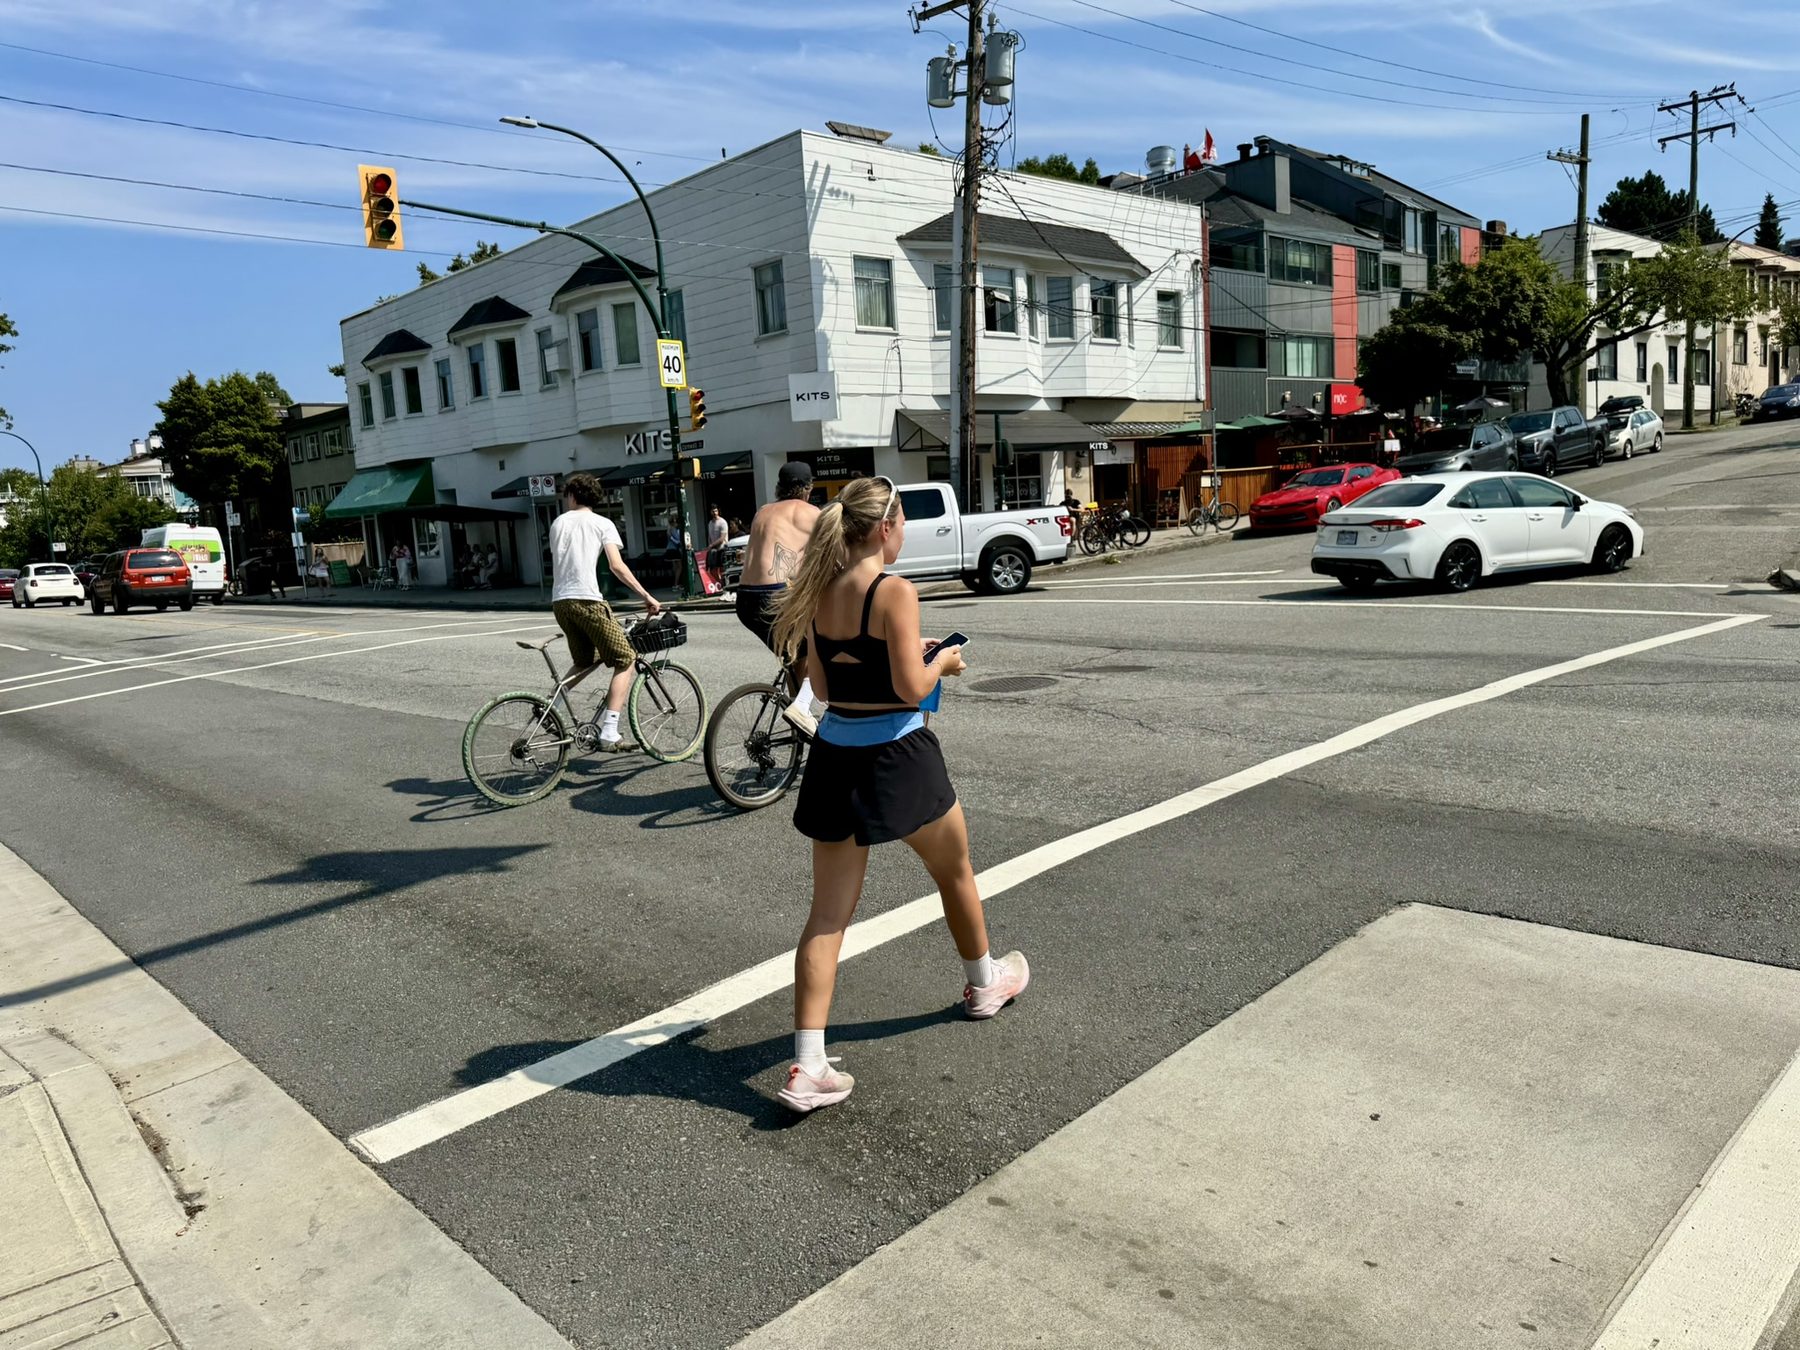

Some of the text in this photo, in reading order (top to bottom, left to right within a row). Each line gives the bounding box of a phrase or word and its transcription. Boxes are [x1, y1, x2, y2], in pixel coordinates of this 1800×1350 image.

[663, 355, 682, 374] 40
[796, 391, 830, 402] KITS
[624, 429, 673, 456] KITS
[1089, 442, 1109, 450] KITS
[816, 455, 841, 463] KITS
[697, 471, 716, 480] KITS
[629, 477, 646, 485] KITS
